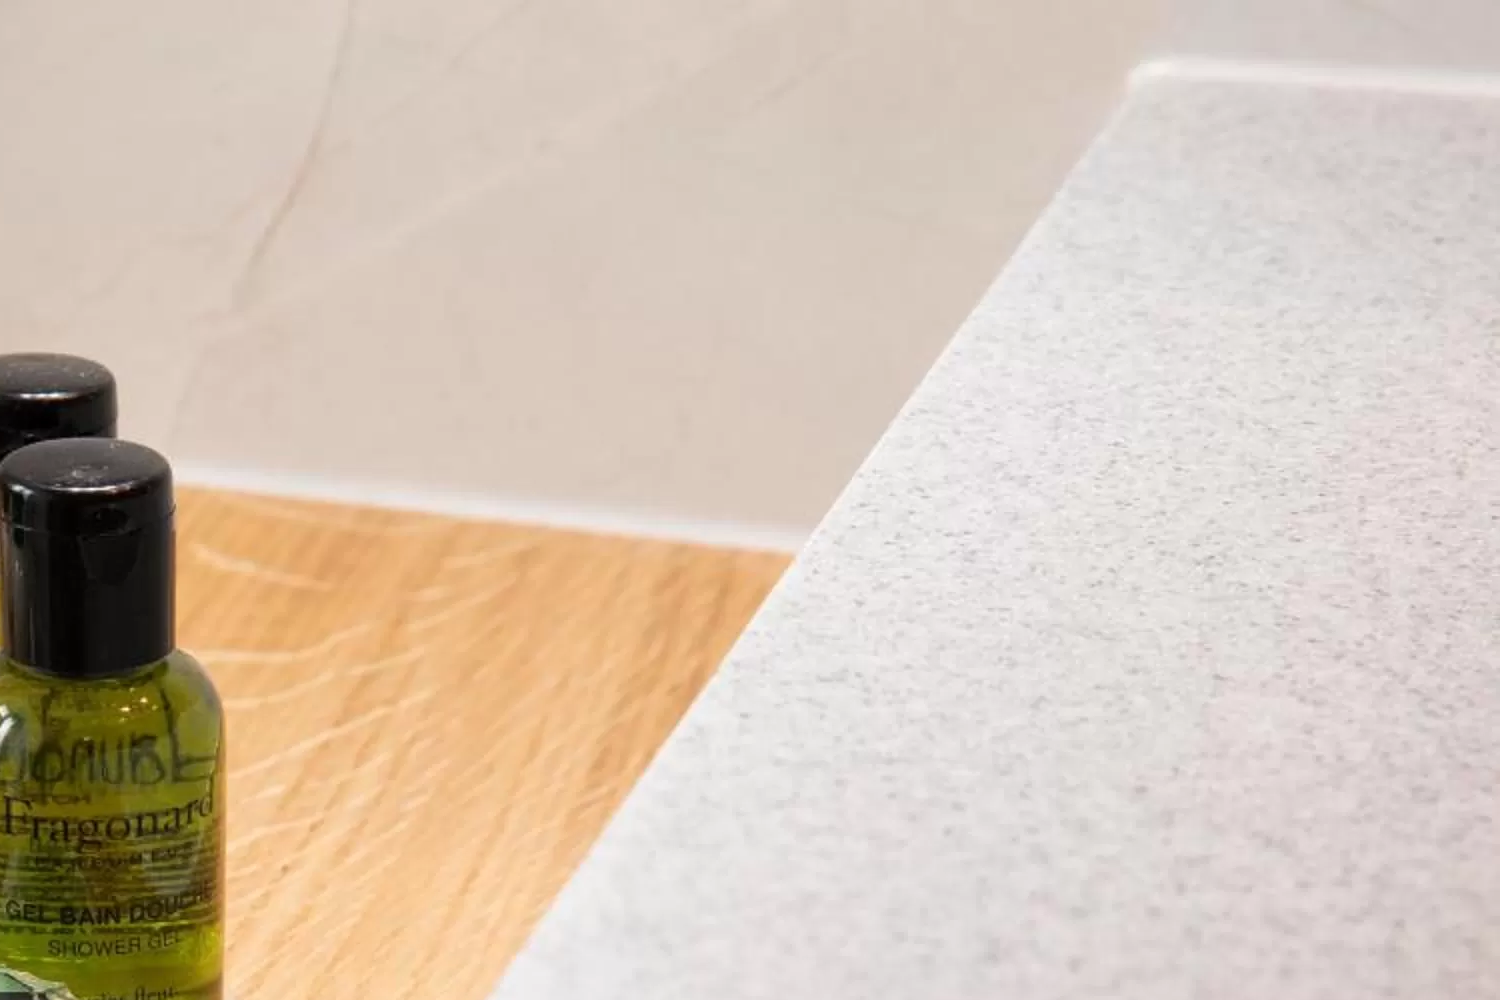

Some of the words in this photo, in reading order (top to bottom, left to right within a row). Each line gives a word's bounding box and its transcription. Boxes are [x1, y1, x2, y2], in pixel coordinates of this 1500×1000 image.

[3, 774, 215, 854] Fragonard
[5, 900, 54, 923] GEL
[59, 905, 121, 926] BAIN
[48, 936, 142, 957] SHOWER
[147, 930, 184, 950] GEL
